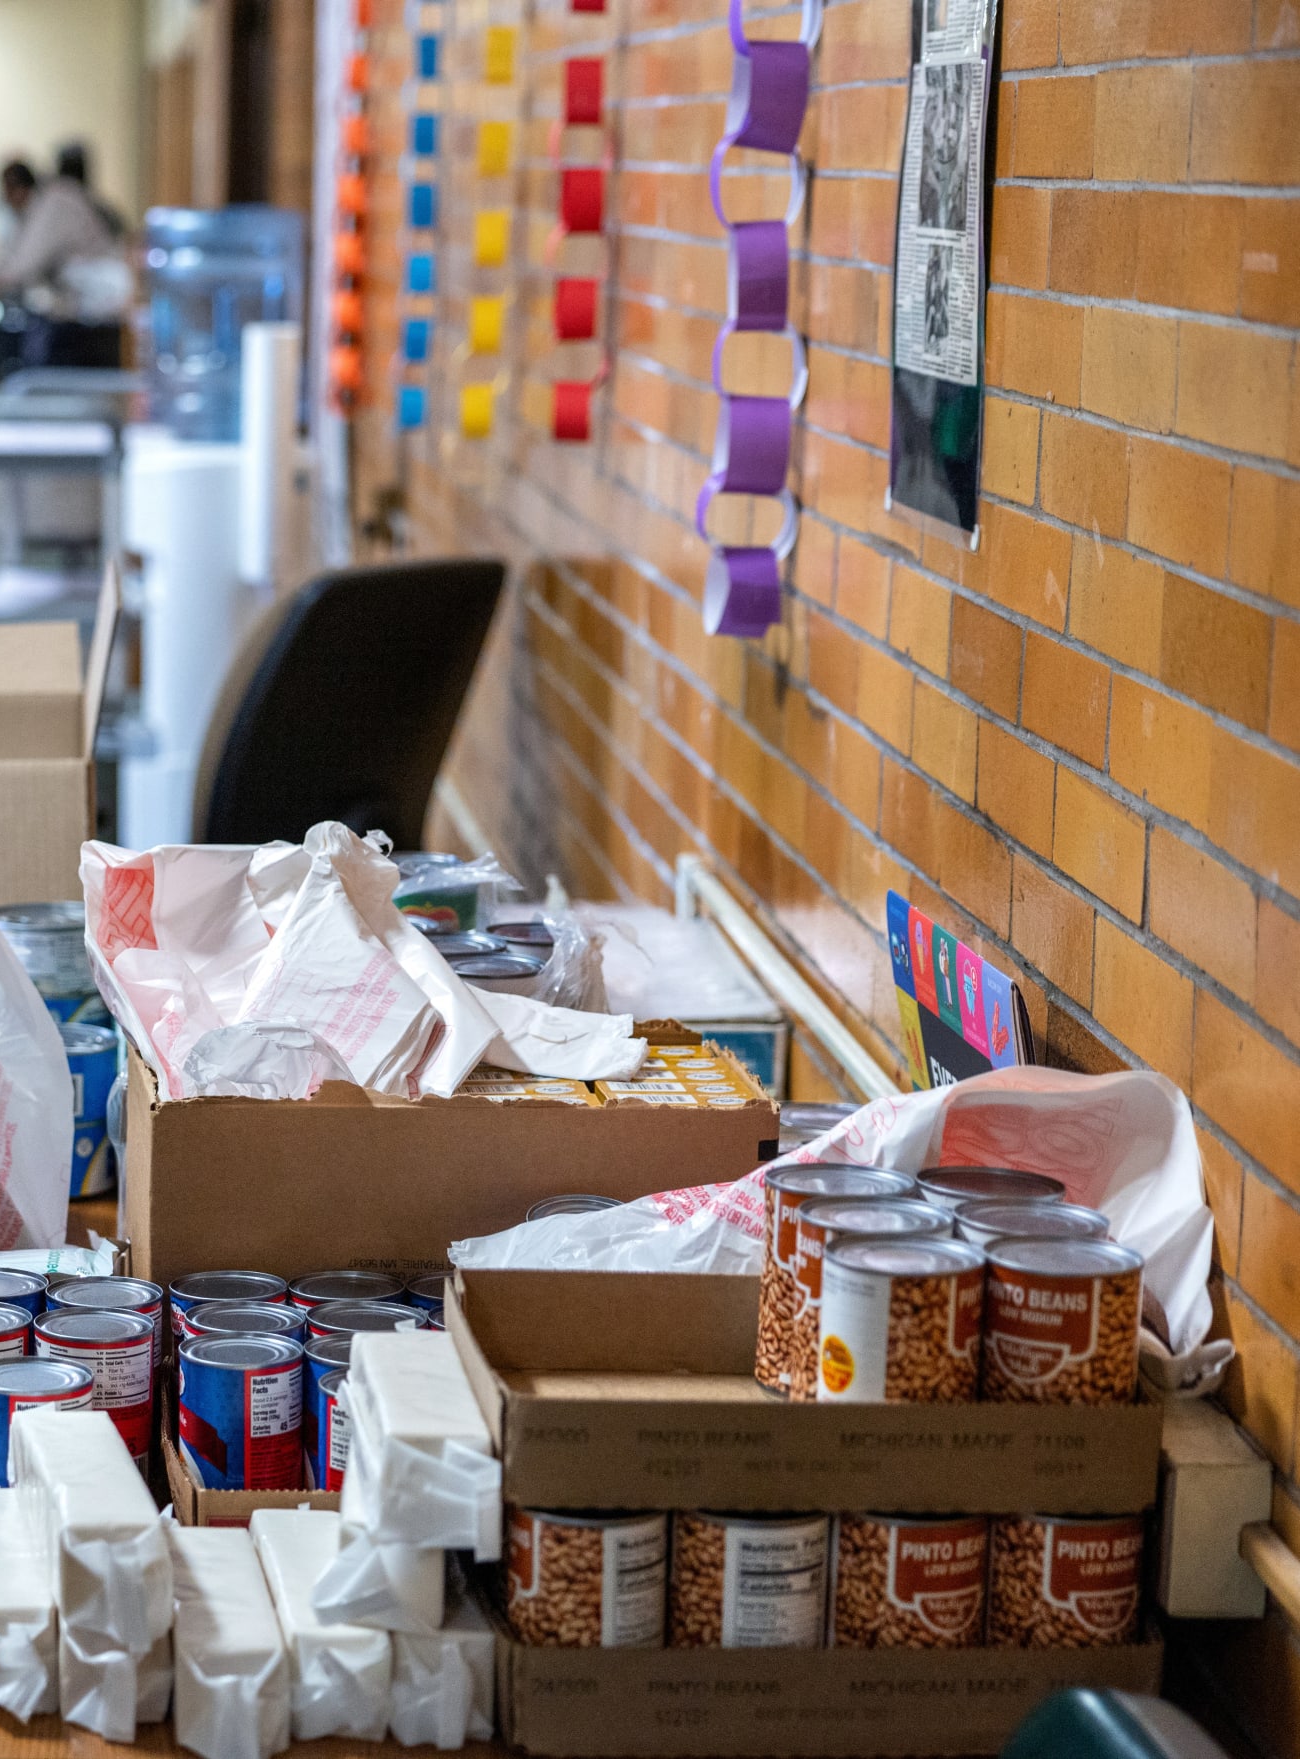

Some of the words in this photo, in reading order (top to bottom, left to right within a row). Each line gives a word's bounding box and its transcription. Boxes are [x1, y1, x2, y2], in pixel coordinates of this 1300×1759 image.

[798, 1234, 823, 1259] EANS
[1027, 1287, 1088, 1312] BEANS
[252, 1377, 278, 1386] Nutrition
[280, 1421, 288, 1431] 45
[637, 1428, 698, 1447] PINTO
[839, 1432, 943, 1450] MICHIGAN
[951, 1433, 1014, 1450] MADE
[901, 1541, 953, 1562] PINTO
[1057, 1540, 1110, 1561] PINTO
[647, 1679, 709, 1695] PINTO
[849, 1679, 958, 1695] MICHIGAN
[965, 1678, 1029, 1695] MADE
